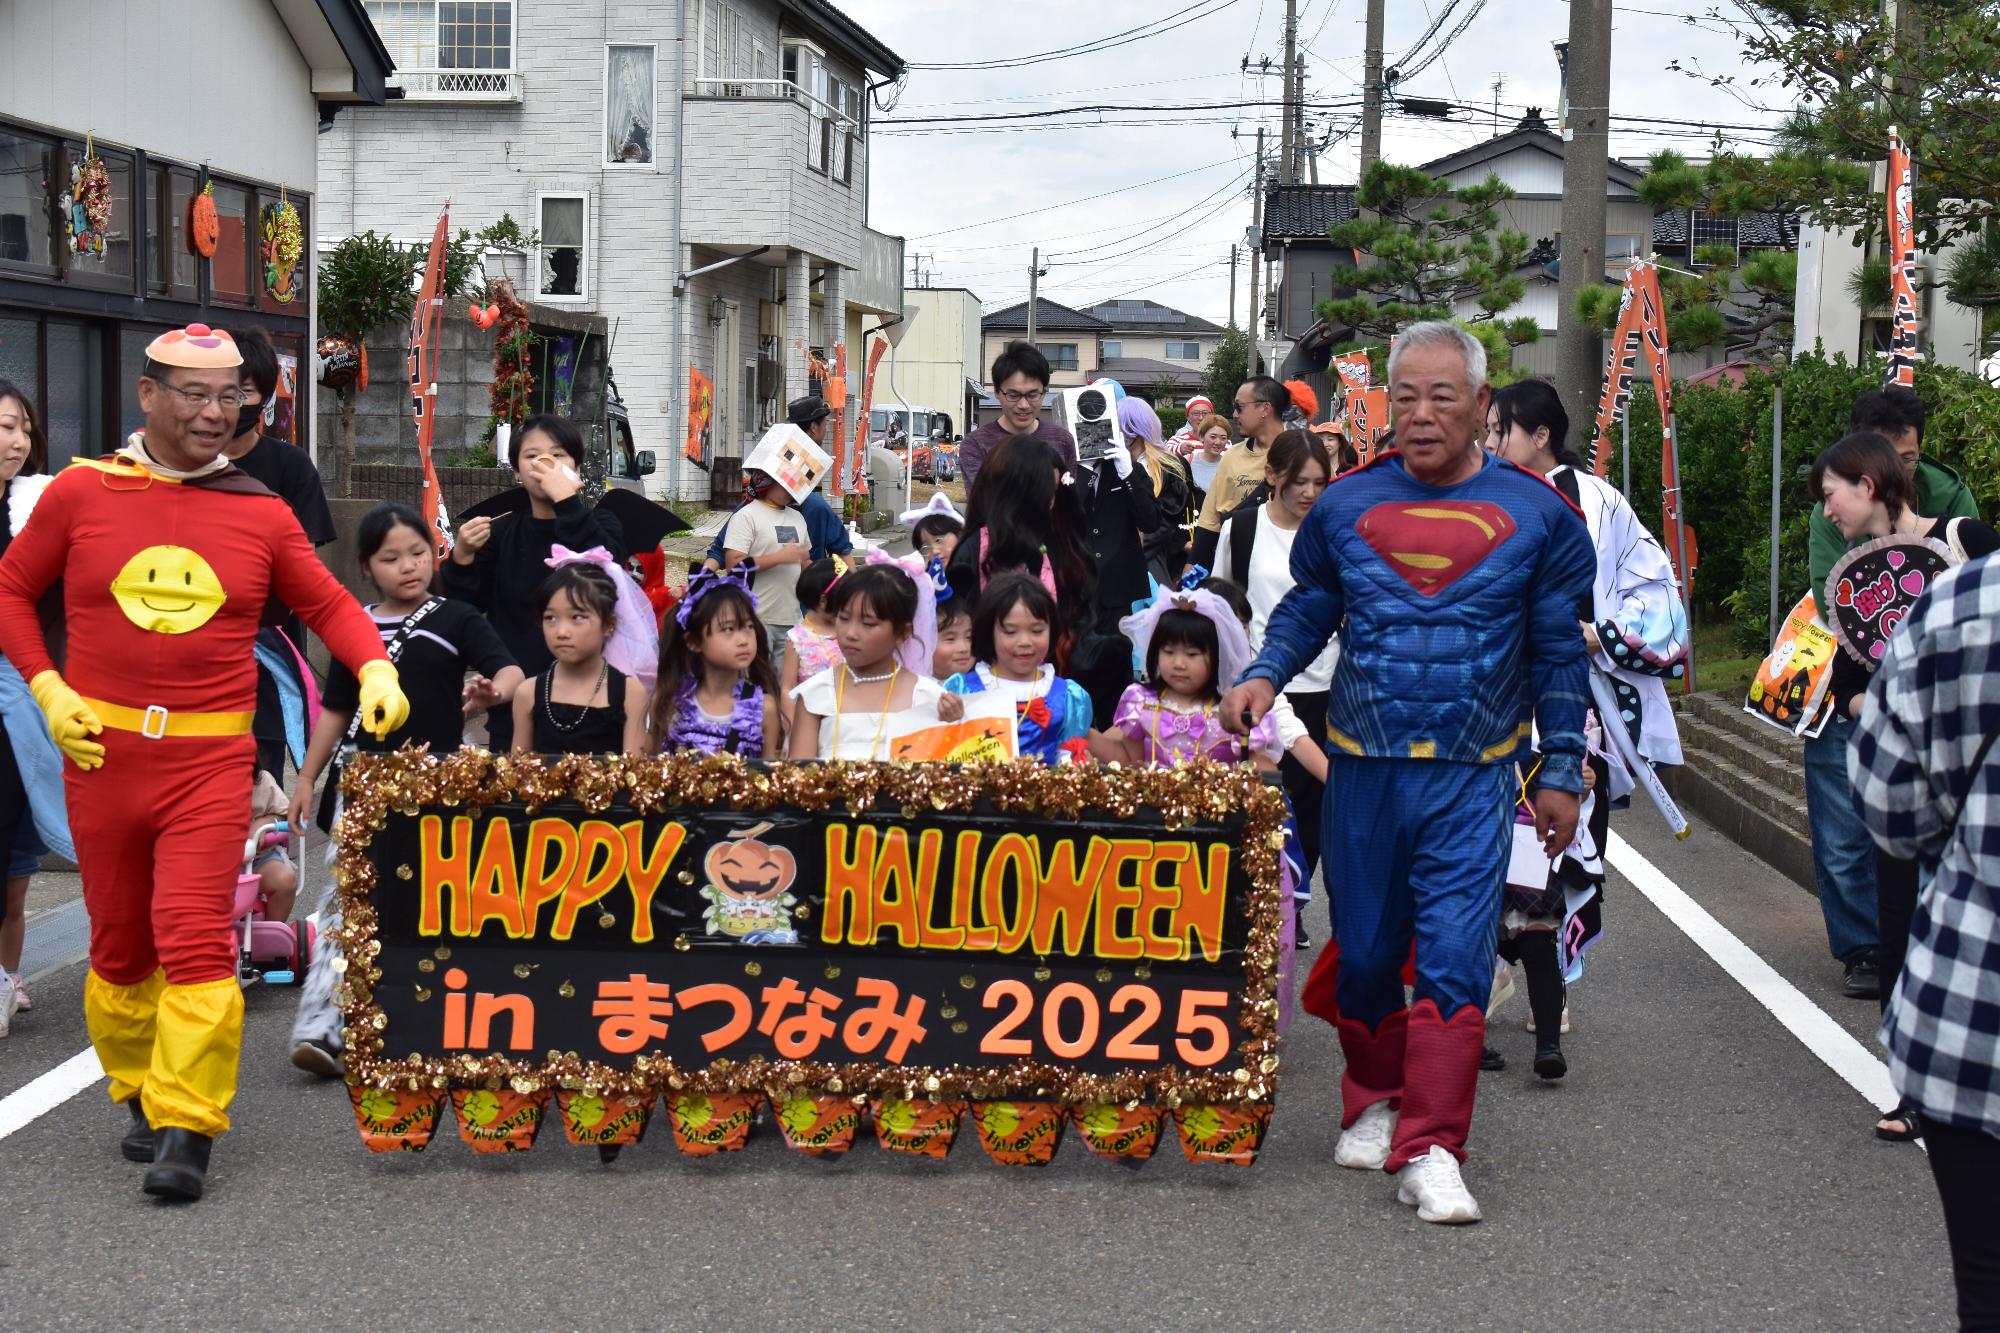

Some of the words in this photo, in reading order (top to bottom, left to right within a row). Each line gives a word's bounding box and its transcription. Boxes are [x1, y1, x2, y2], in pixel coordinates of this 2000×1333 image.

[418, 814, 687, 944] HAPPY
[820, 823, 1231, 962] HALLOWEEN
[443, 967, 535, 1050] in
[592, 973, 928, 1064] まつなみ
[980, 979, 1231, 1067] 2025
